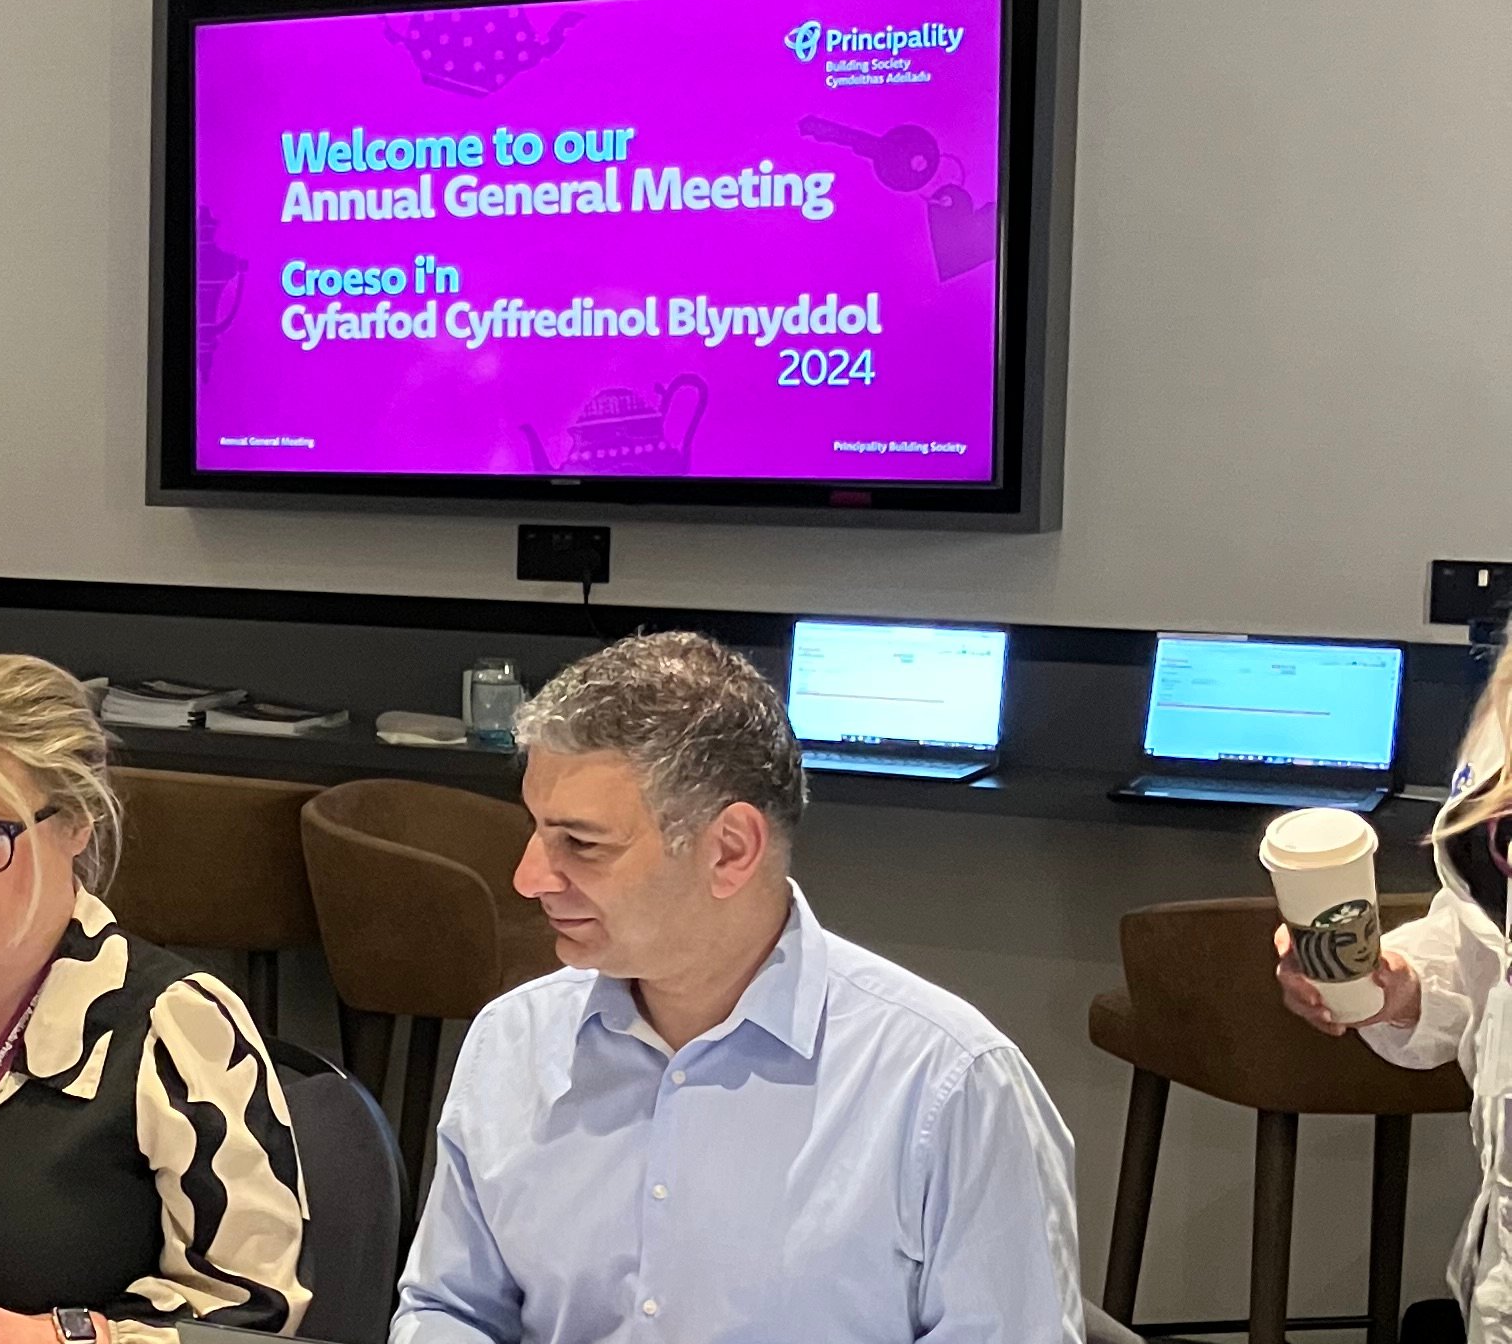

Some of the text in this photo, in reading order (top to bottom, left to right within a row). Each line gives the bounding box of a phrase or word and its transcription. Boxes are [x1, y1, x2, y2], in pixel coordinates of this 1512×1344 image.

[825, 23, 965, 55] Principality
[825, 57, 911, 73] Building Society
[281, 127, 635, 175] Welcome to our
[281, 160, 835, 223] Annual General Meeting
[281, 255, 460, 297] Croeso i'n
[281, 293, 883, 351] Cyfarfod Cyffredinol Blynyddol
[777, 349, 876, 386] 2024
[833, 441, 967, 455] Principality Building Society
